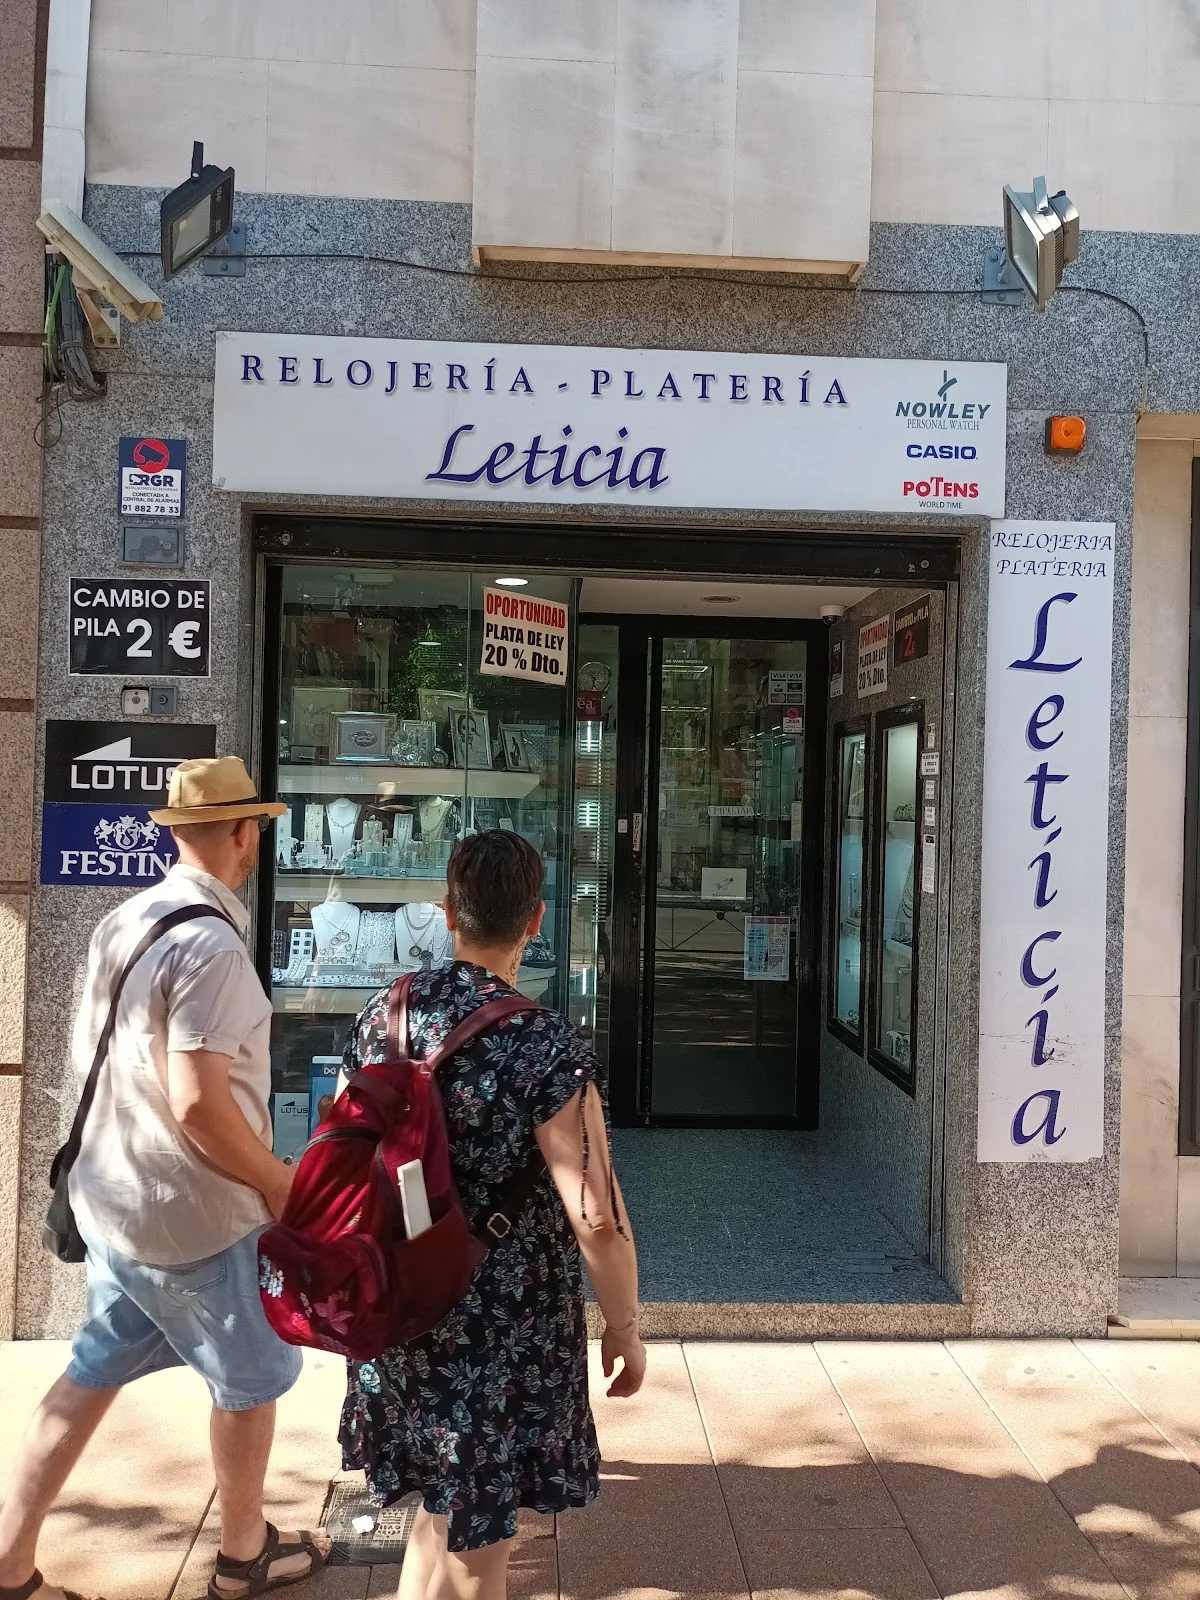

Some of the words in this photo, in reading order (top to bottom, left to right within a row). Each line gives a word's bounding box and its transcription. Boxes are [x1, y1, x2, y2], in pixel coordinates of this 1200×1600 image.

[241, 354, 534, 394] RELOJERÍA
[591, 369, 848, 405] PLATERÍA
[895, 401, 991, 420] NOWLEY
[907, 418, 948, 430] PERSONAL
[949, 420, 980, 431] WATCH
[425, 424, 668, 491] Leticia
[906, 444, 977, 460] CASIO
[903, 477, 979, 498] POTENS
[168, 506, 179, 514] 33
[946, 501, 962, 509] TIME
[992, 532, 1113, 553] RELOJERIA
[996, 557, 1107, 577] PLATERIA
[73, 588, 170, 609] CAMBIO
[177, 590, 205, 609] DE
[486, 593, 565, 629] OPORTUNIDAD
[917, 605, 928, 621] PILA
[73, 617, 120, 637] PILA
[126, 618, 152, 657] 2
[168, 620, 201, 659] €
[485, 622, 524, 644] PLATA
[527, 630, 542, 647] DE
[544, 633, 565, 651] LEY
[484, 644, 508, 667] 20
[512, 648, 527, 670] %
[531, 652, 564, 676] Dto.
[872, 650, 878, 664] DE
[878, 646, 887, 662] LEY
[858, 671, 866, 691] 20
[59, 850, 173, 876] FESTIN
